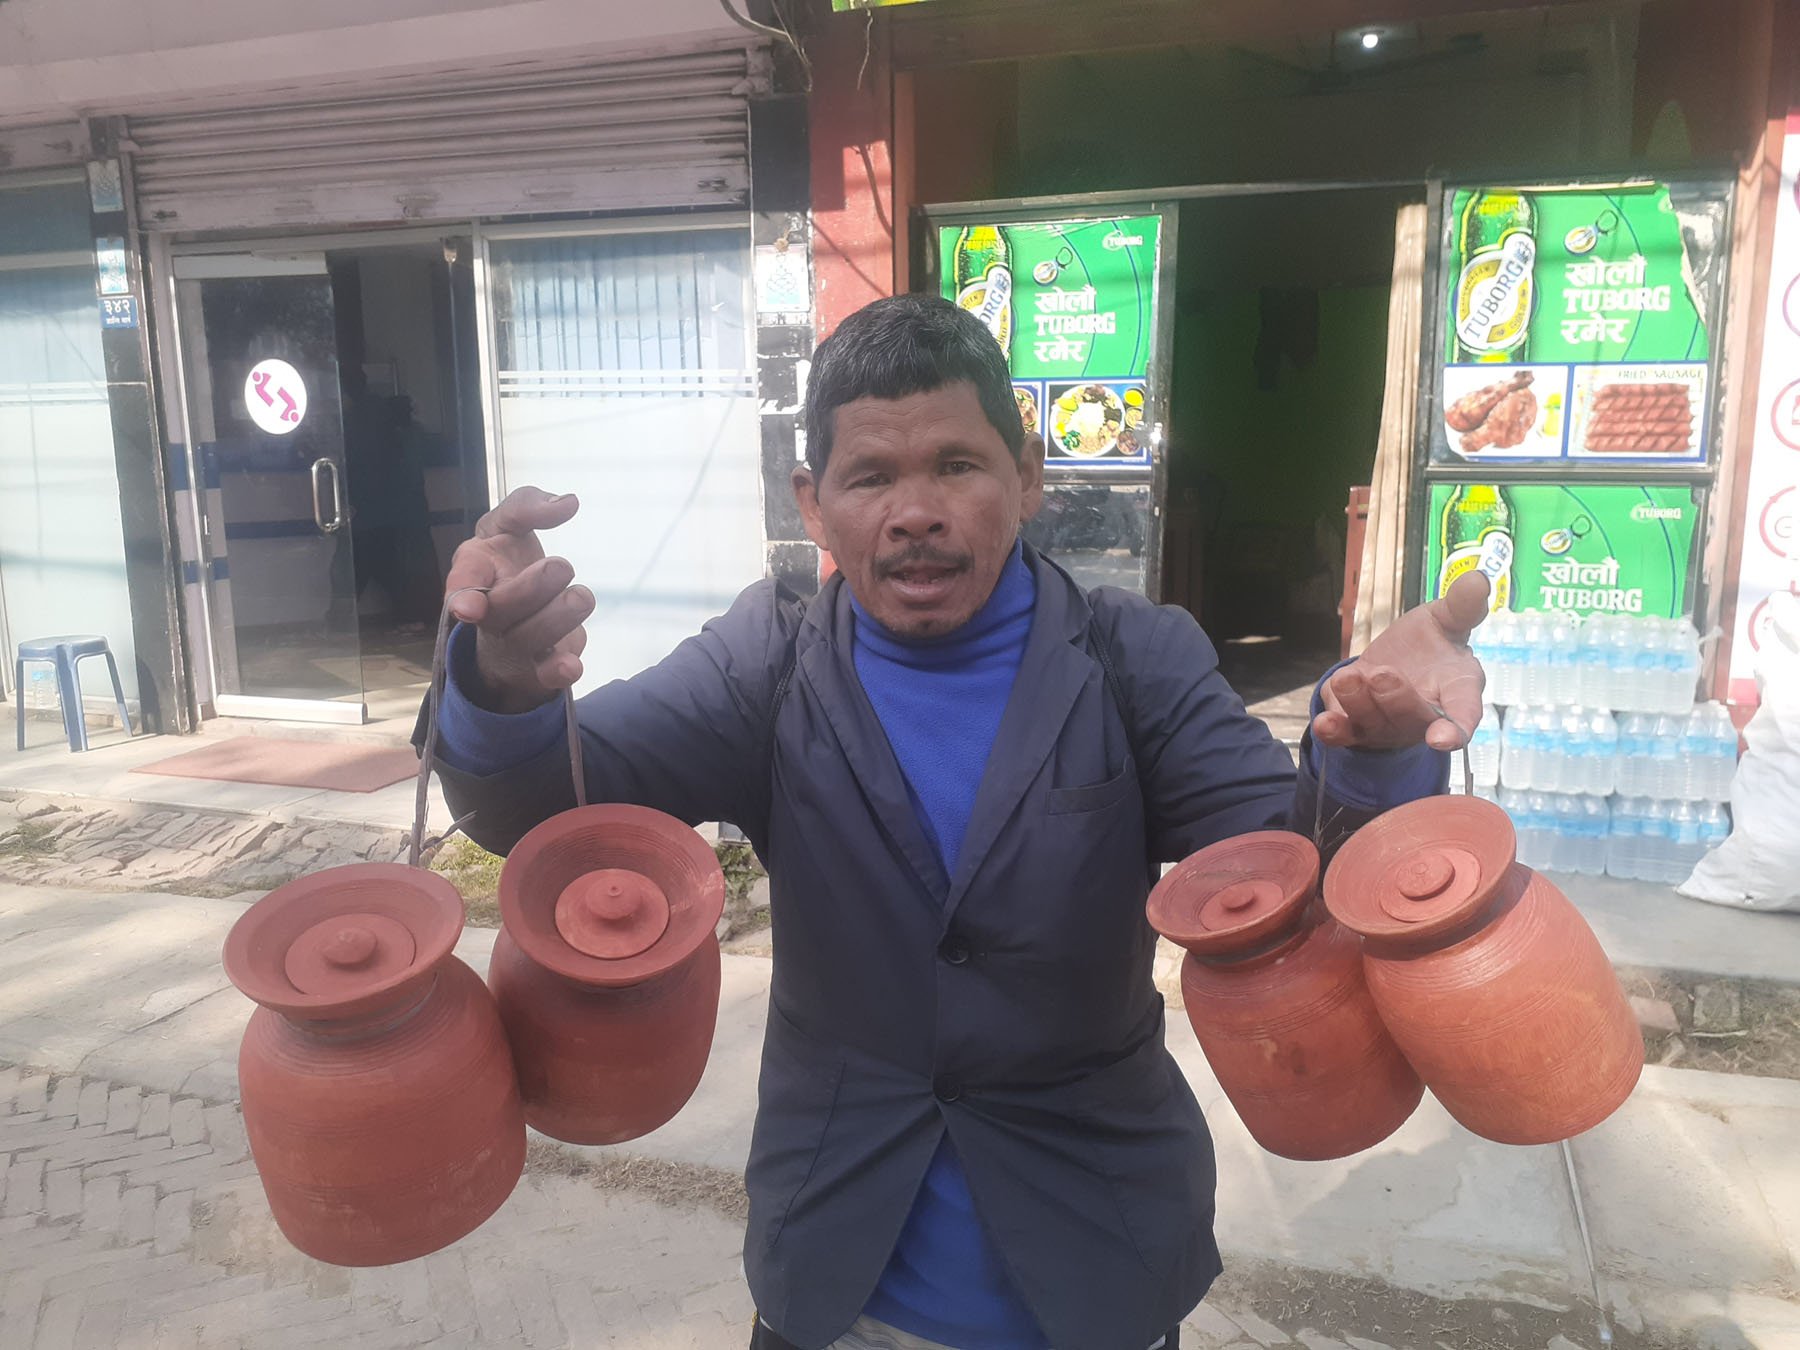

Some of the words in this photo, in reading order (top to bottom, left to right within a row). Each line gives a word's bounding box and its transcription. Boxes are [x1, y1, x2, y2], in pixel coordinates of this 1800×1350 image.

[103, 299, 131, 315] ३४२
[979, 290, 1004, 326] ORG
[1464, 260, 1524, 338] TUBORG
[1563, 285, 1671, 313] TUBORG
[1034, 312, 1117, 336] TUBORG
[1638, 507, 1682, 520] TUBORG
[1540, 586, 1643, 612] TUBORG
